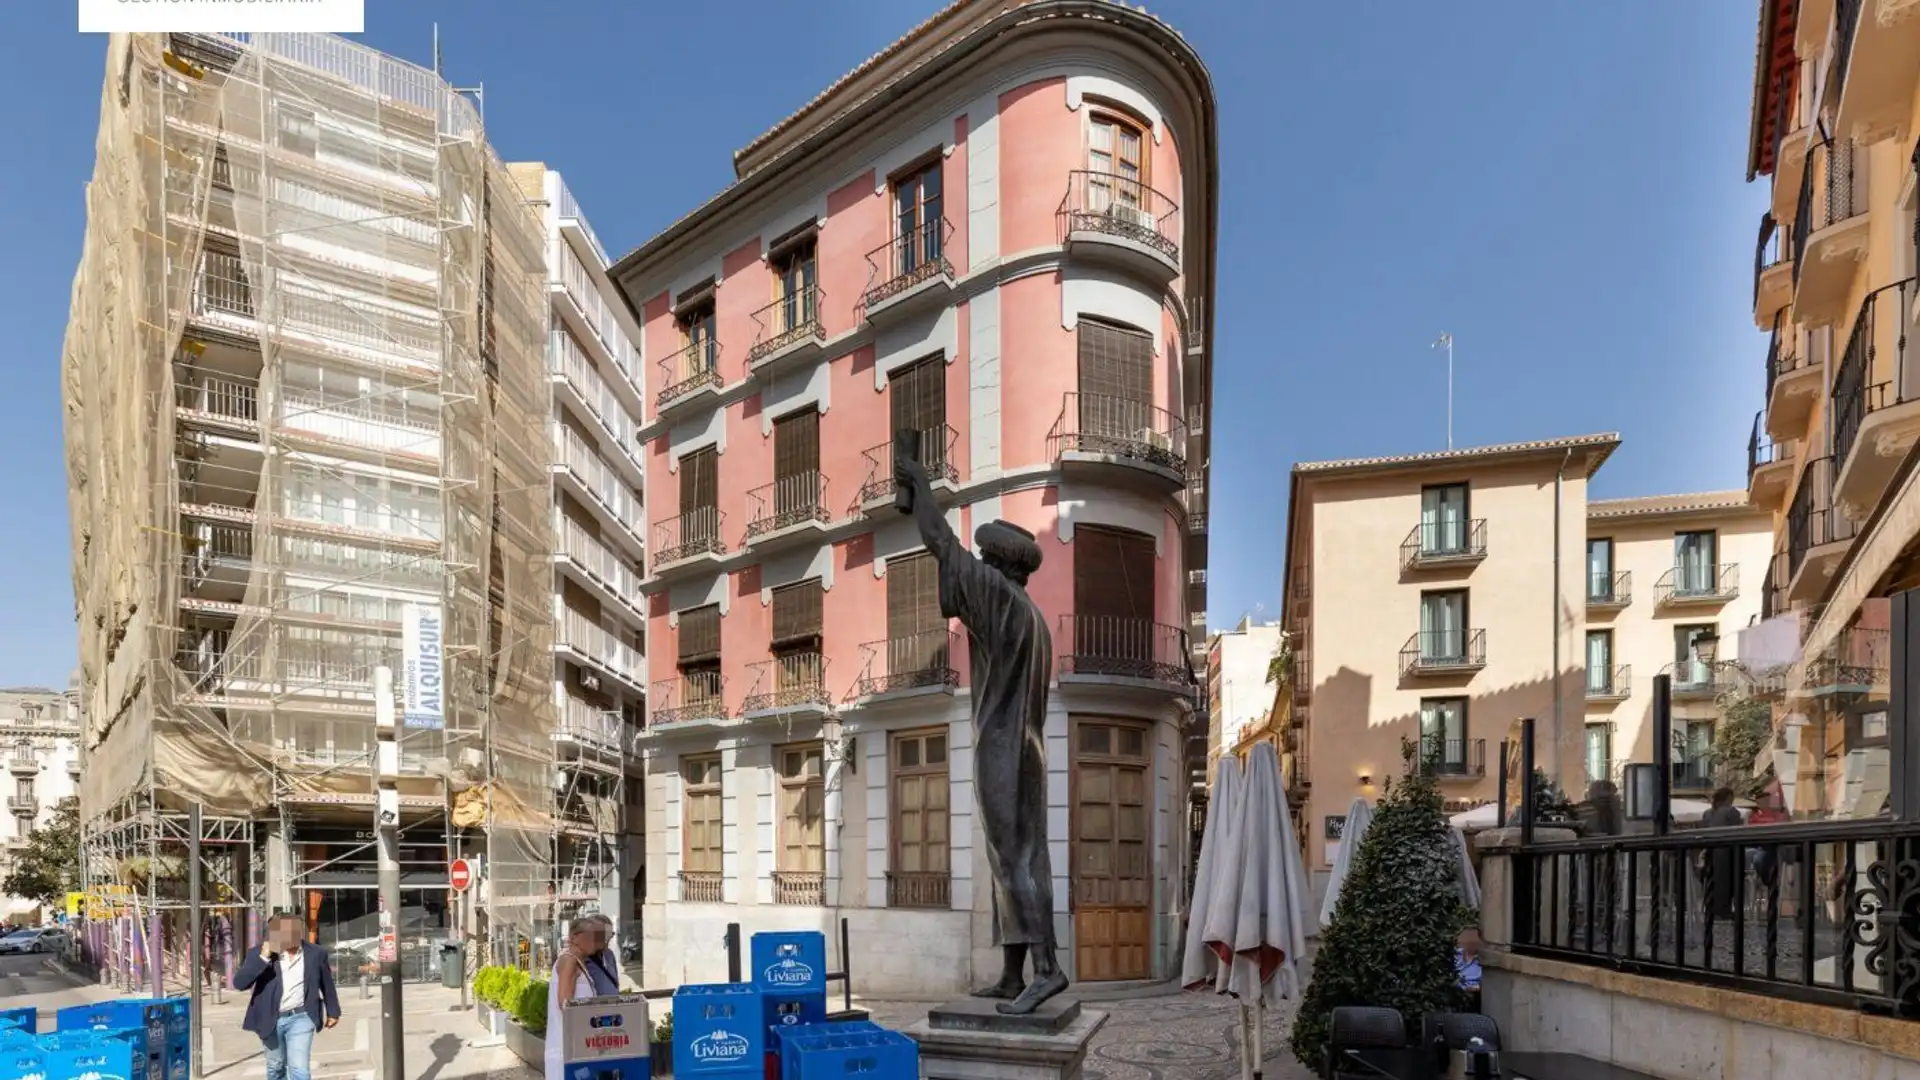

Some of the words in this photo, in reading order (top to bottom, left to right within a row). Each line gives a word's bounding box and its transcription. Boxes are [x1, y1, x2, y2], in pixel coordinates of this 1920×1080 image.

[420, 617, 440, 711] ALQUISUR
[767, 969, 812, 982] Liviana
[585, 1034, 630, 1049] VICTORIA
[694, 1043, 747, 1058] Liviana
